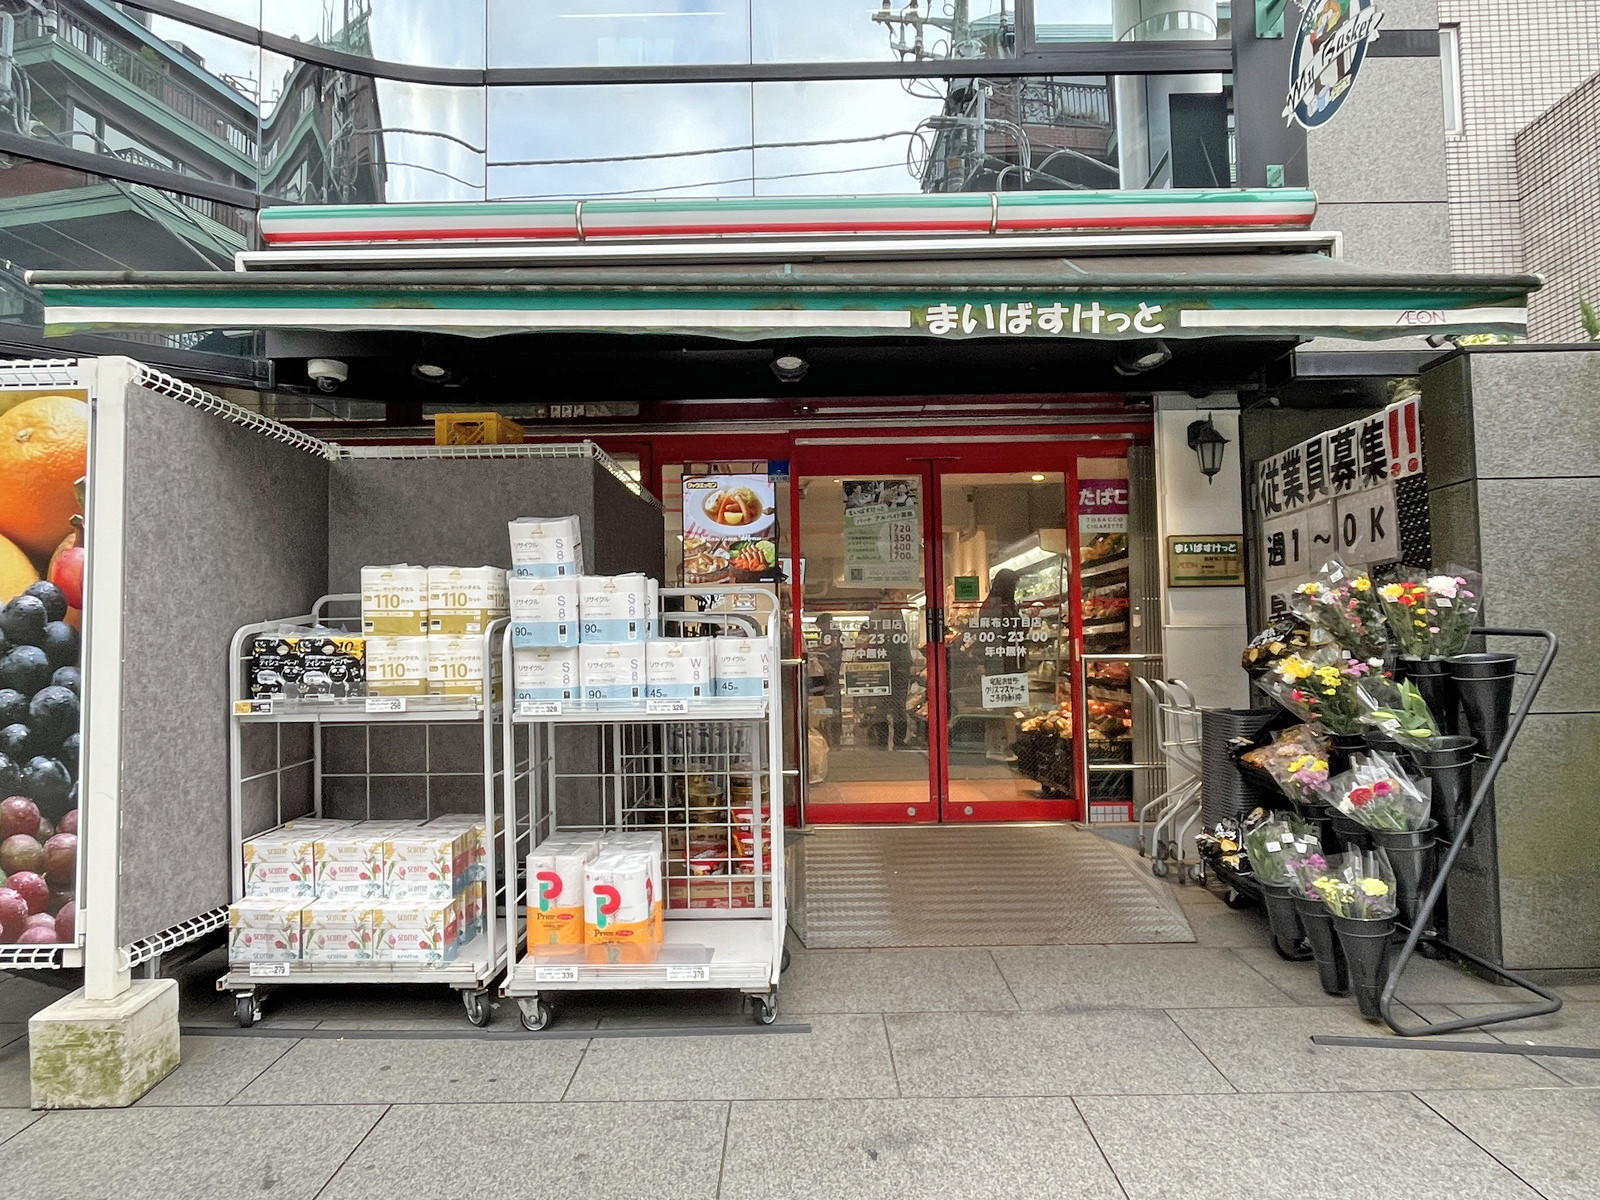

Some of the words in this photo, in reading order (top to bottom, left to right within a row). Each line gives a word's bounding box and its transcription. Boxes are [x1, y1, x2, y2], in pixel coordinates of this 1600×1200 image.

[925, 302, 1165, 334] まいばすけっと
[1079, 487, 1128, 505] たばこ
[556, 539, 563, 548] S
[1174, 543, 1237, 553] まいばすけっと
[557, 551, 564, 559] 8
[374, 594, 400, 608] 110
[441, 592, 467, 607] 110
[557, 595, 565, 606] S
[628, 593, 635, 603] S
[558, 609, 565, 618] 8
[628, 606, 635, 615] 8
[985, 646, 1027, 657] 年中無休
[562, 662, 570, 672] S
[631, 659, 638, 669] S
[690, 658, 701, 668] W
[379, 663, 405, 678] 110
[440, 663, 467, 678] 110
[693, 671, 700, 680] 8
[563, 675, 570, 684] 8
[632, 671, 638, 681] 8
[985, 685, 1025, 694] クリスマスケーキ
